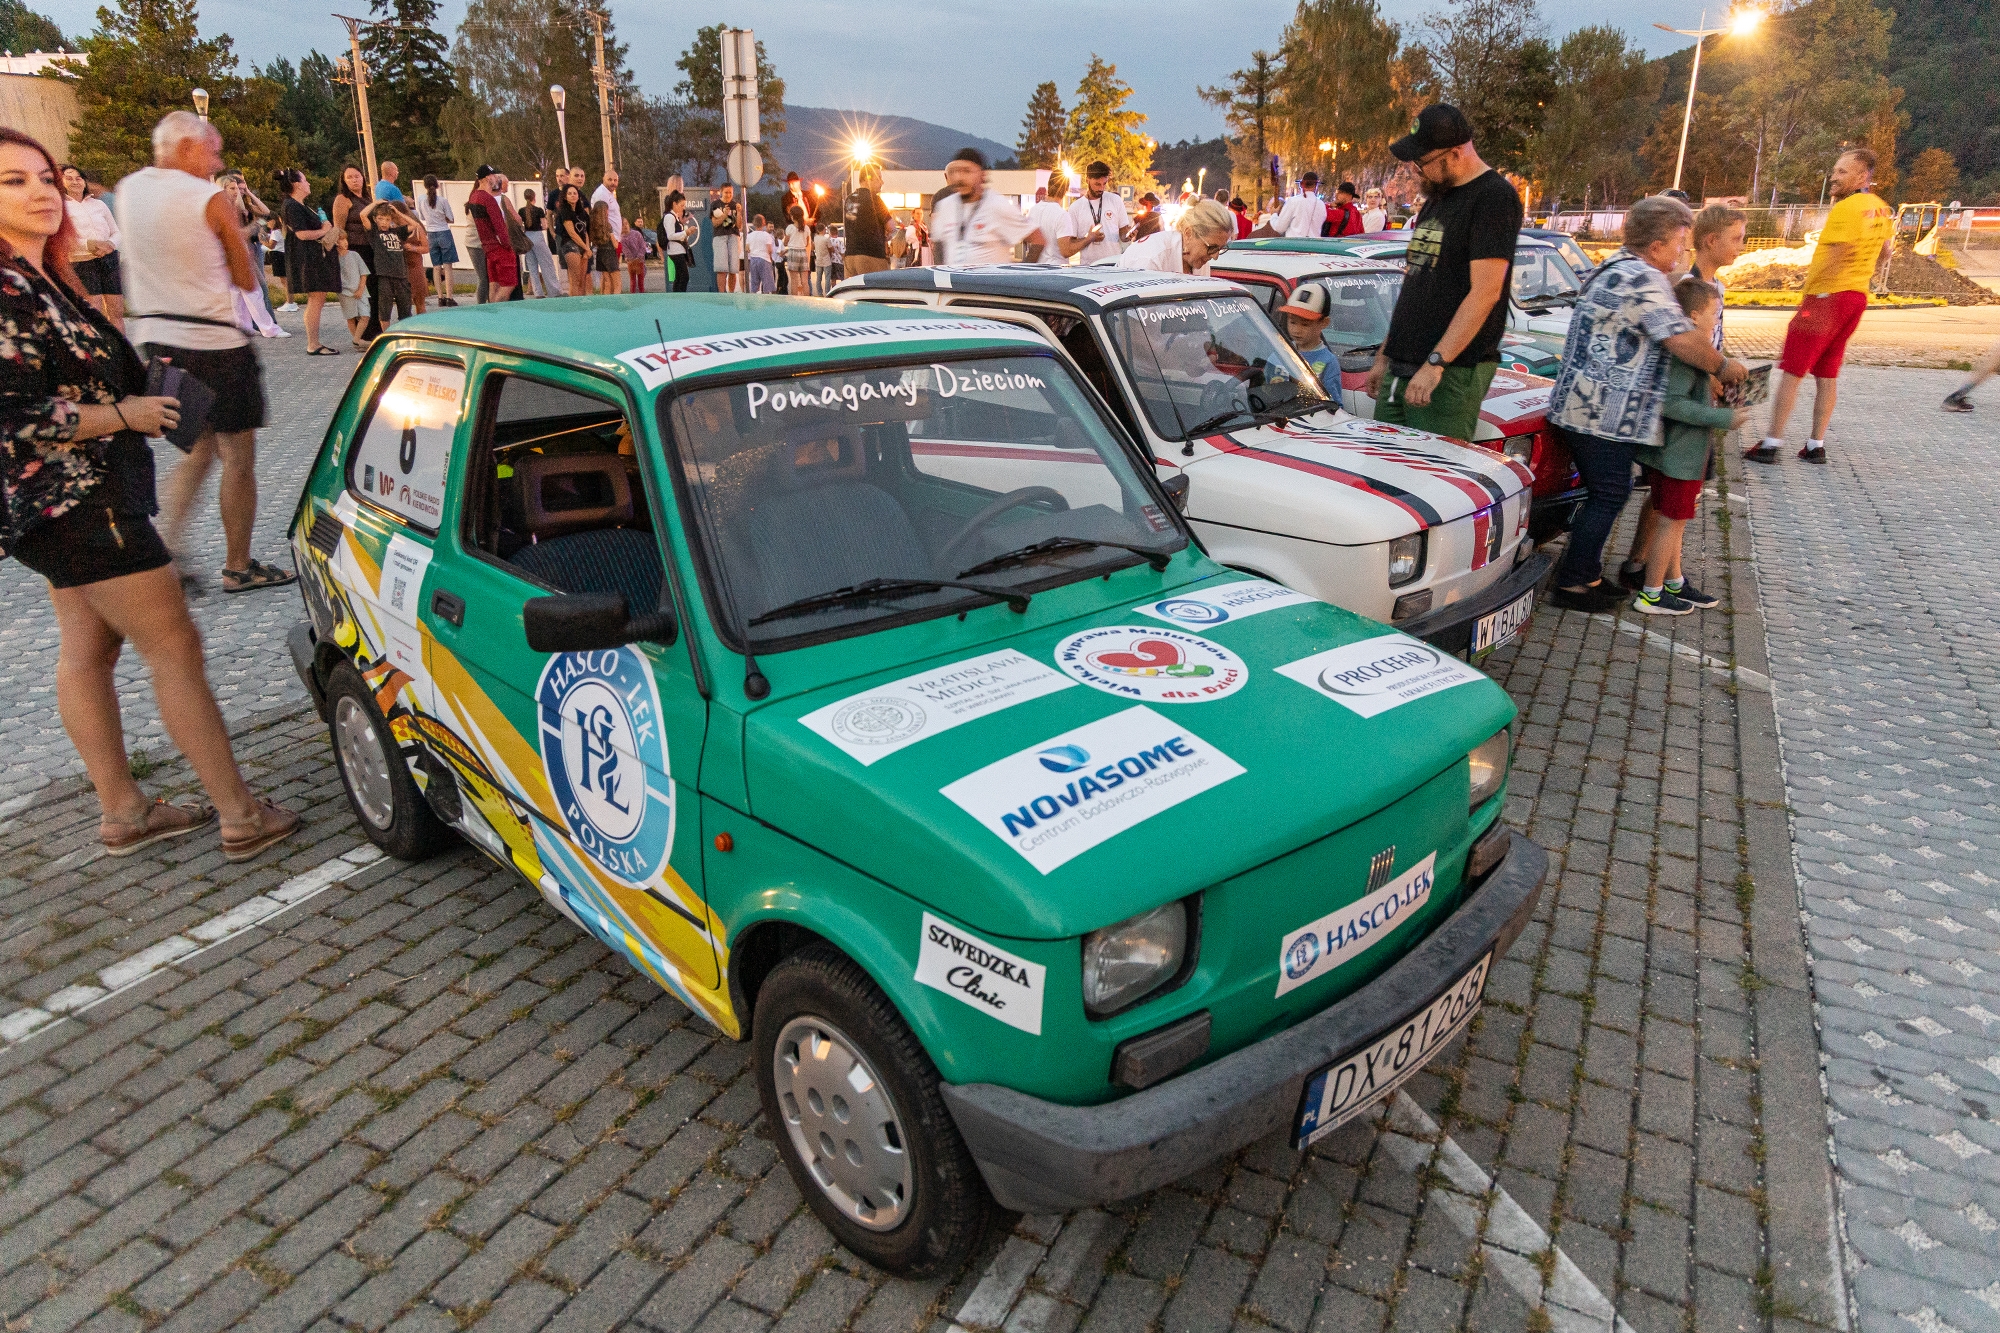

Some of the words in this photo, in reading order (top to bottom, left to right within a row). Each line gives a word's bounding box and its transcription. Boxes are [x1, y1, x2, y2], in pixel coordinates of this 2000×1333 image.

[1121, 187, 1131, 201] P
[1325, 276, 1378, 290] Pomagamy
[1137, 304, 1207, 327] Pomagamy
[1207, 299, 1252, 317] Dzieciom
[747, 376, 917, 419] Pomagamy
[929, 364, 1047, 398] Dzieciom
[1222, 589, 1295, 608] HASCO-LEK
[1062, 628, 1122, 661] Wyprawa
[1128, 628, 1231, 661] Maluchów
[1480, 615, 1496, 648] W1
[549, 650, 620, 700] HASCO
[907, 655, 1027, 693] VRATISLAVIA
[1073, 664, 1142, 696] Wielka
[1202, 668, 1238, 694] Dzieci
[1333, 651, 1431, 687] PROCEFAR
[925, 675, 1005, 702] MEDICA
[1161, 690, 1200, 699] dla
[1001, 736, 1197, 838] NOVASOME
[1019, 813, 1081, 851] Centrum
[1079, 756, 1210, 821] Badawczo-Rozwojowe
[567, 802, 648, 875] POLSKA
[1326, 866, 1432, 955] HASCO-LEK
[928, 924, 1031, 989] SZWEDZKA
[946, 966, 1007, 1010] Clinic
[1329, 1043, 1386, 1115] DX
[1392, 963, 1484, 1072] 81268
[1302, 1109, 1317, 1127] PL
